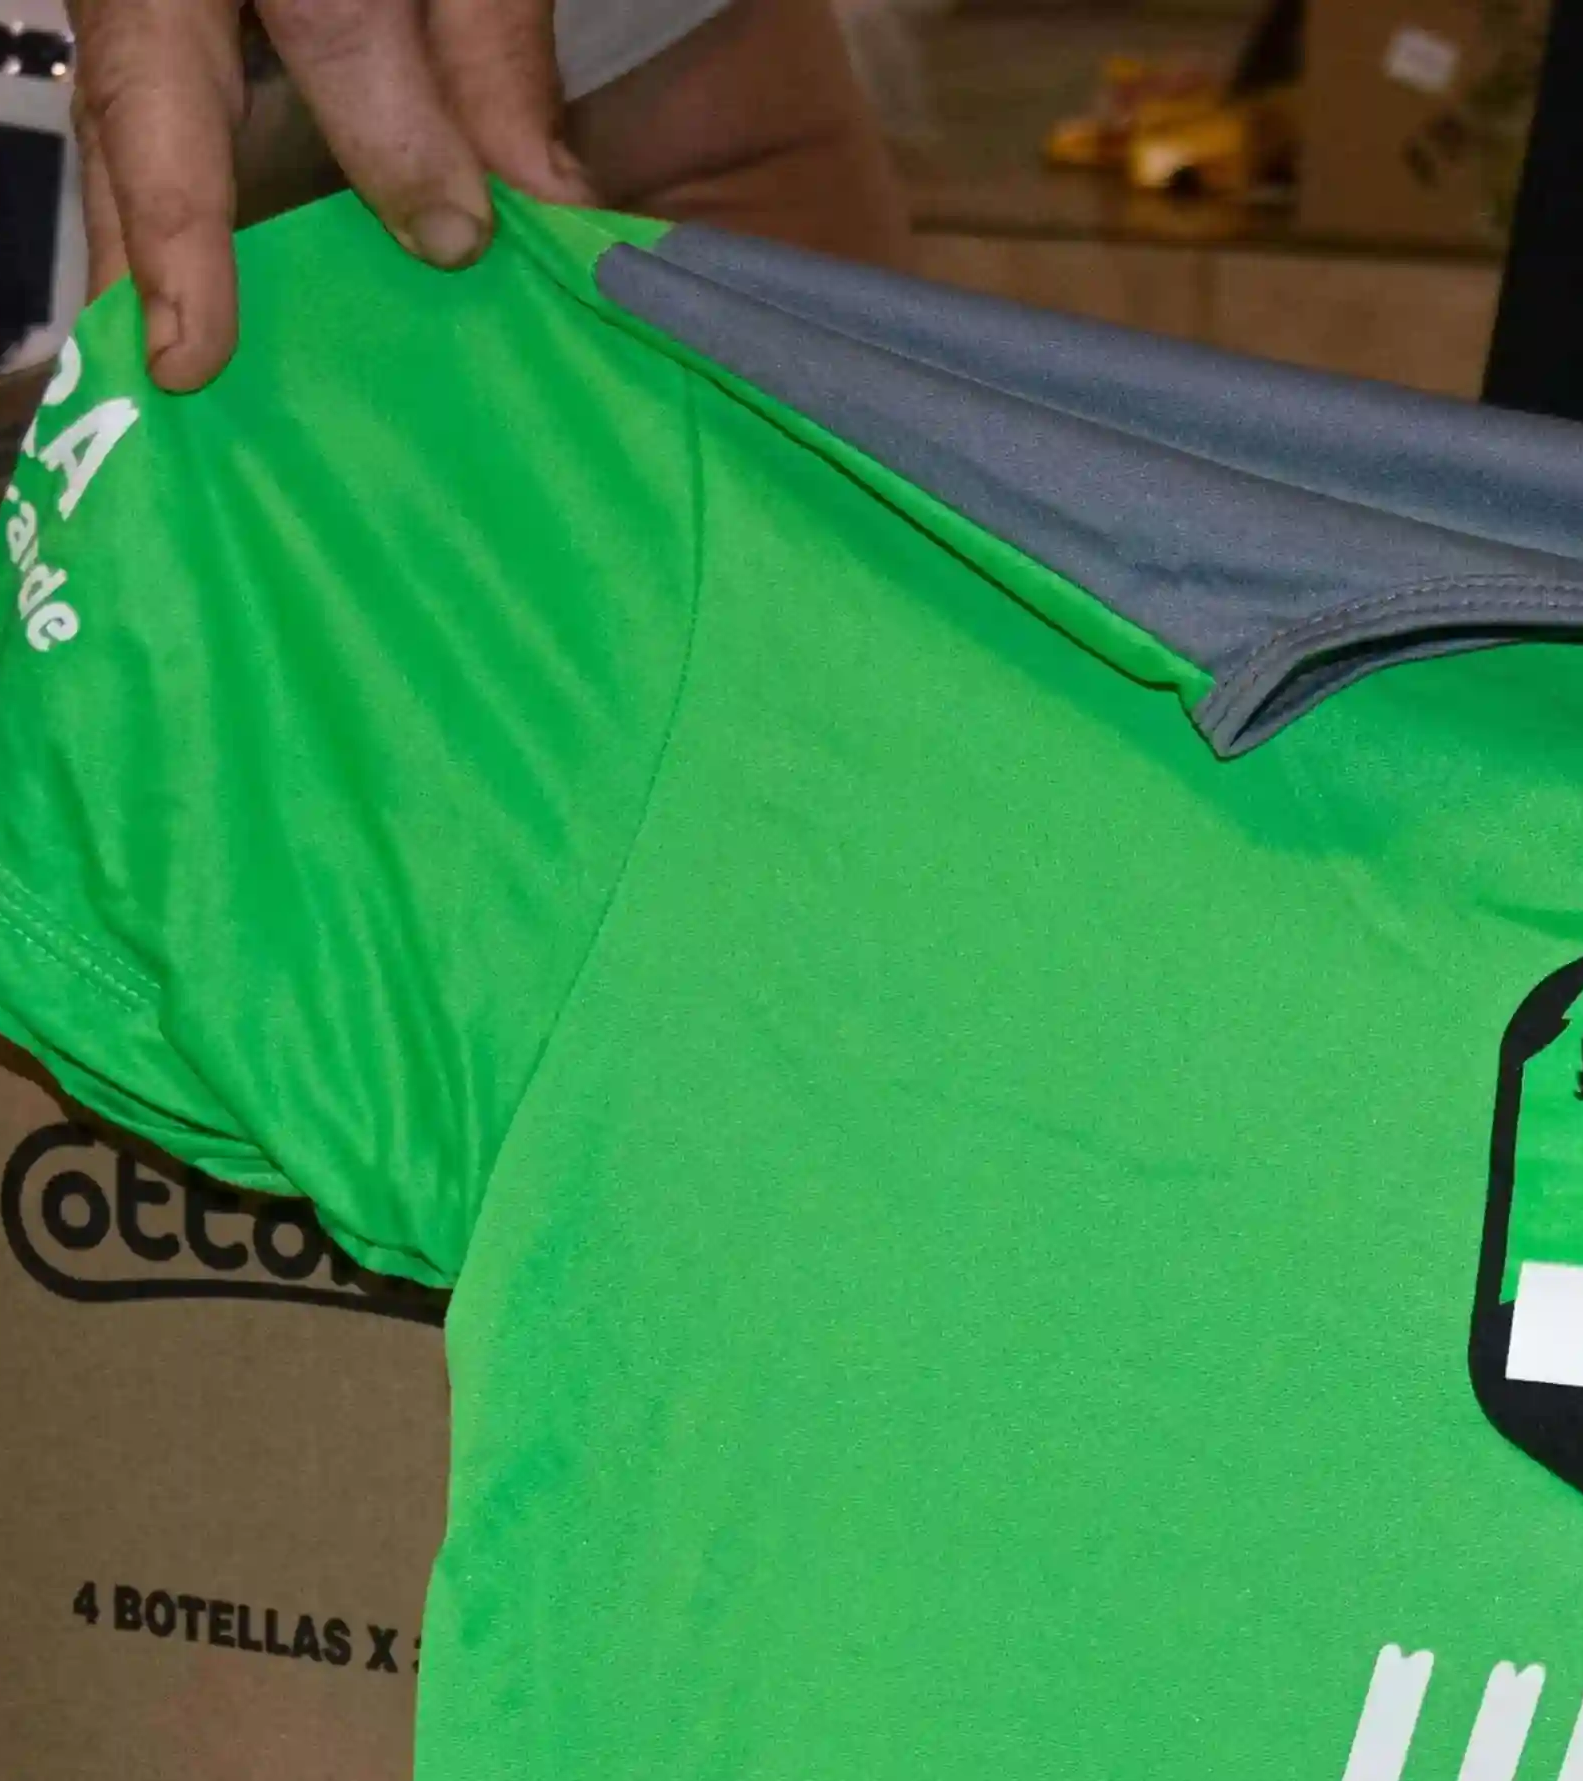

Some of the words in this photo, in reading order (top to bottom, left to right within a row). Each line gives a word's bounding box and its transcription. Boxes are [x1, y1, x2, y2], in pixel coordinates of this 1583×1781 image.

[5, 484, 81, 652] ande
[73, 1581, 99, 1625] 4
[113, 1585, 351, 1666] BOTELLAS
[365, 1624, 399, 1674] X
